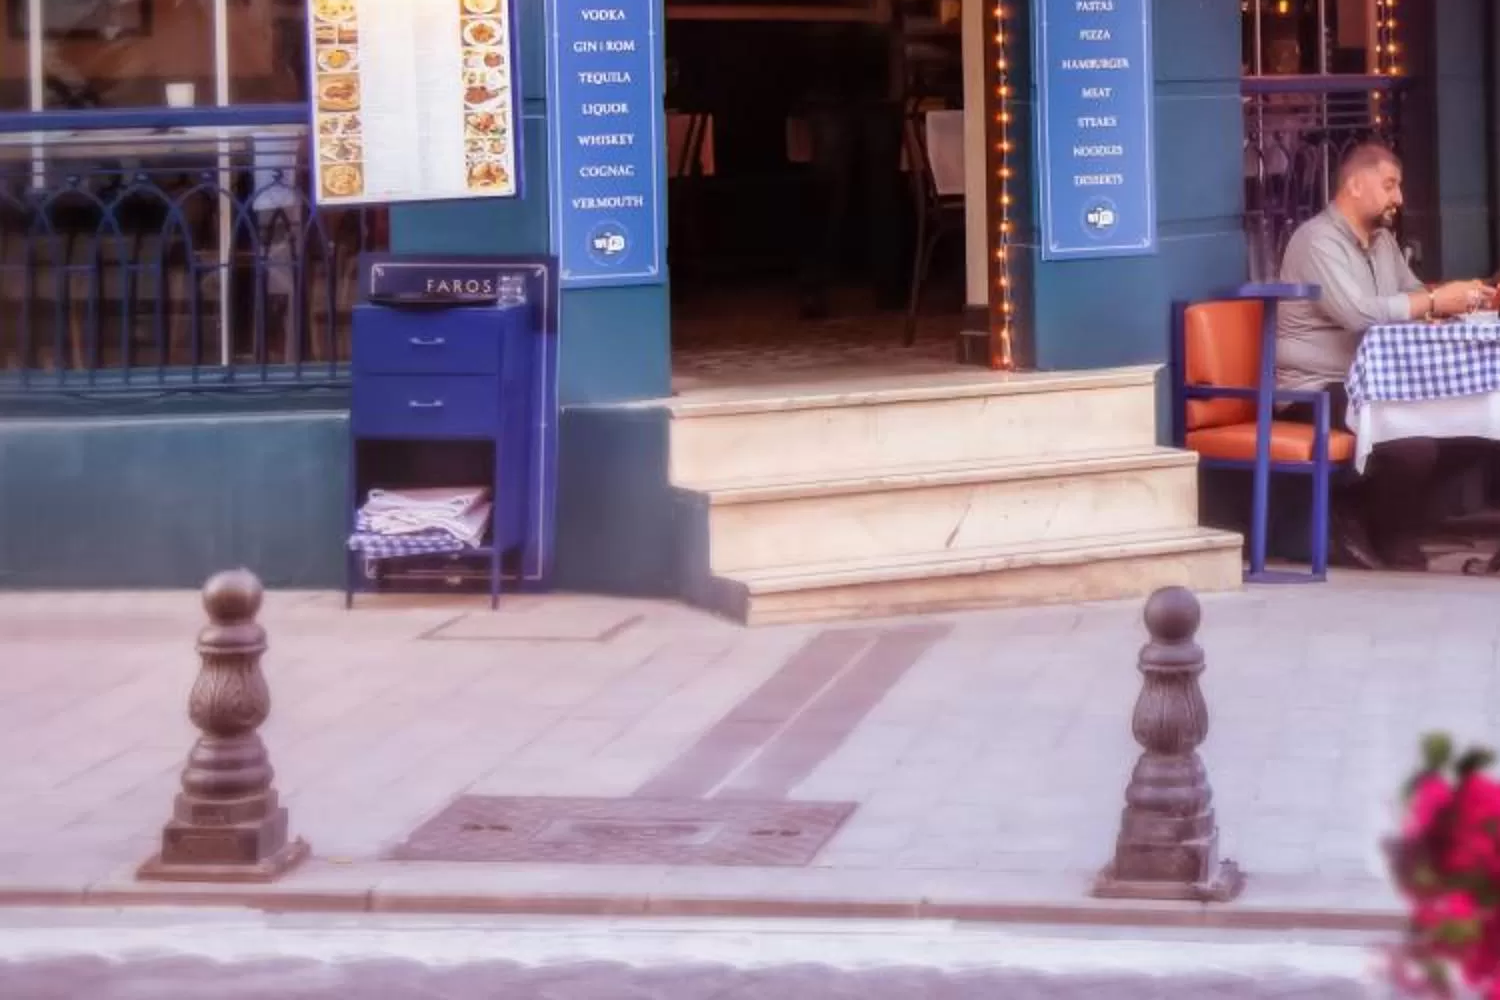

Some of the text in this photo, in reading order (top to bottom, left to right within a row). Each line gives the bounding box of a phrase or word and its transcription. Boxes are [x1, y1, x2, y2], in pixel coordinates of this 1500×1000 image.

[581, 9, 625, 21] VODKA
[1080, 29, 1111, 41] PIZZA
[573, 41, 597, 52] GIN
[578, 72, 631, 84] TEQUILA
[1081, 87, 1112, 98] MEAT
[582, 104, 628, 116] LIQUOR
[577, 133, 634, 146] WHISKEY
[579, 164, 634, 177] COGNAC
[572, 195, 643, 209] VERMOUTH
[427, 279, 492, 293] FAROS
